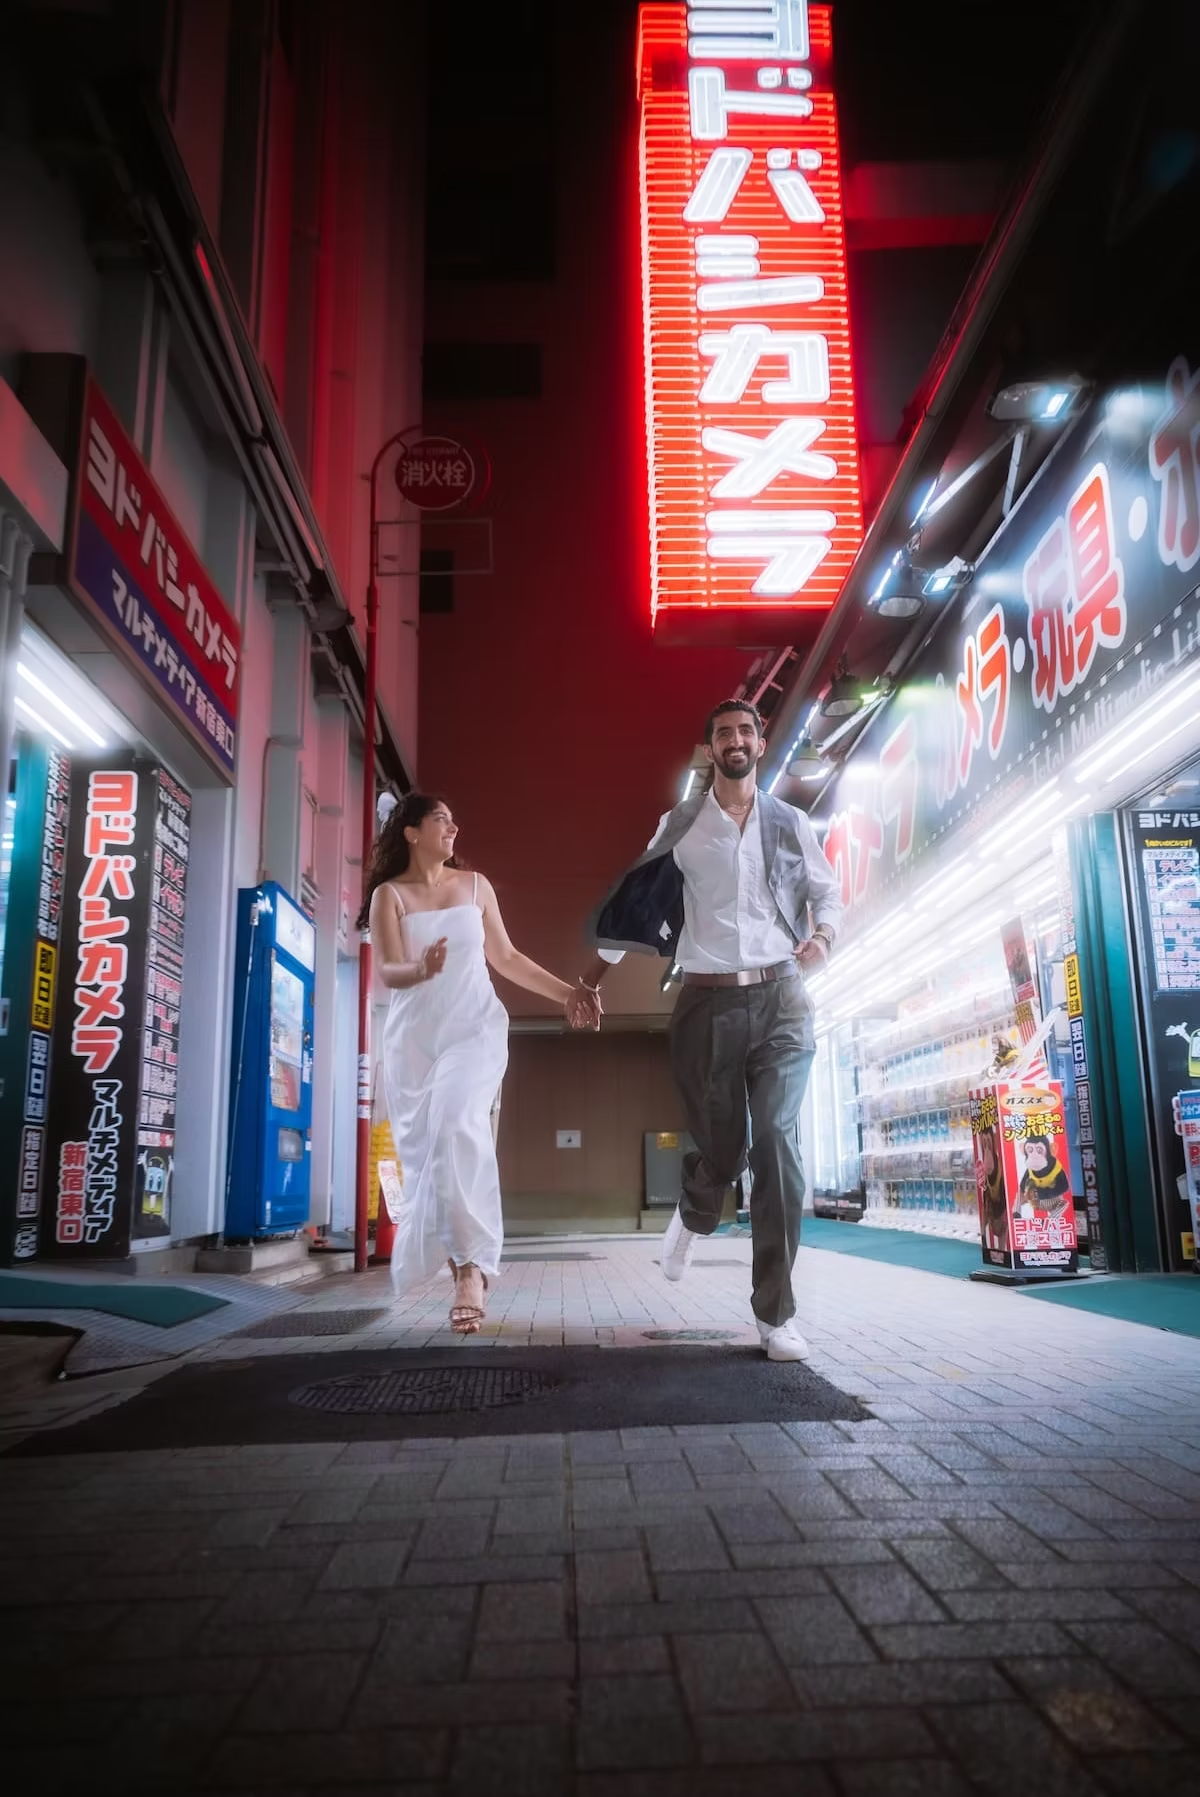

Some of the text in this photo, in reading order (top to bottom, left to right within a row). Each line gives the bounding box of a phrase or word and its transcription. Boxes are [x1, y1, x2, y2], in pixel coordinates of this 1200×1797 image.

[682, 0, 838, 596] ヨドバシカメラ
[401, 460, 467, 487] 消火栓
[87, 416, 237, 690] ヨドバシカメラ
[111, 568, 234, 760] マルチメディア新宿東口
[1070, 659, 1166, 754] Multimedia
[1159, 860, 1192, 873] テレビ
[71, 770, 137, 1073] ヨドバシカメラ
[84, 1079, 122, 1243] マルチメディア
[1004, 1124, 1064, 1141] シンバルくん
[1026, 1112, 1061, 1126] おさるの
[56, 1141, 87, 1243] 新宿東口
[1014, 1218, 1073, 1231] ヨドバシ
